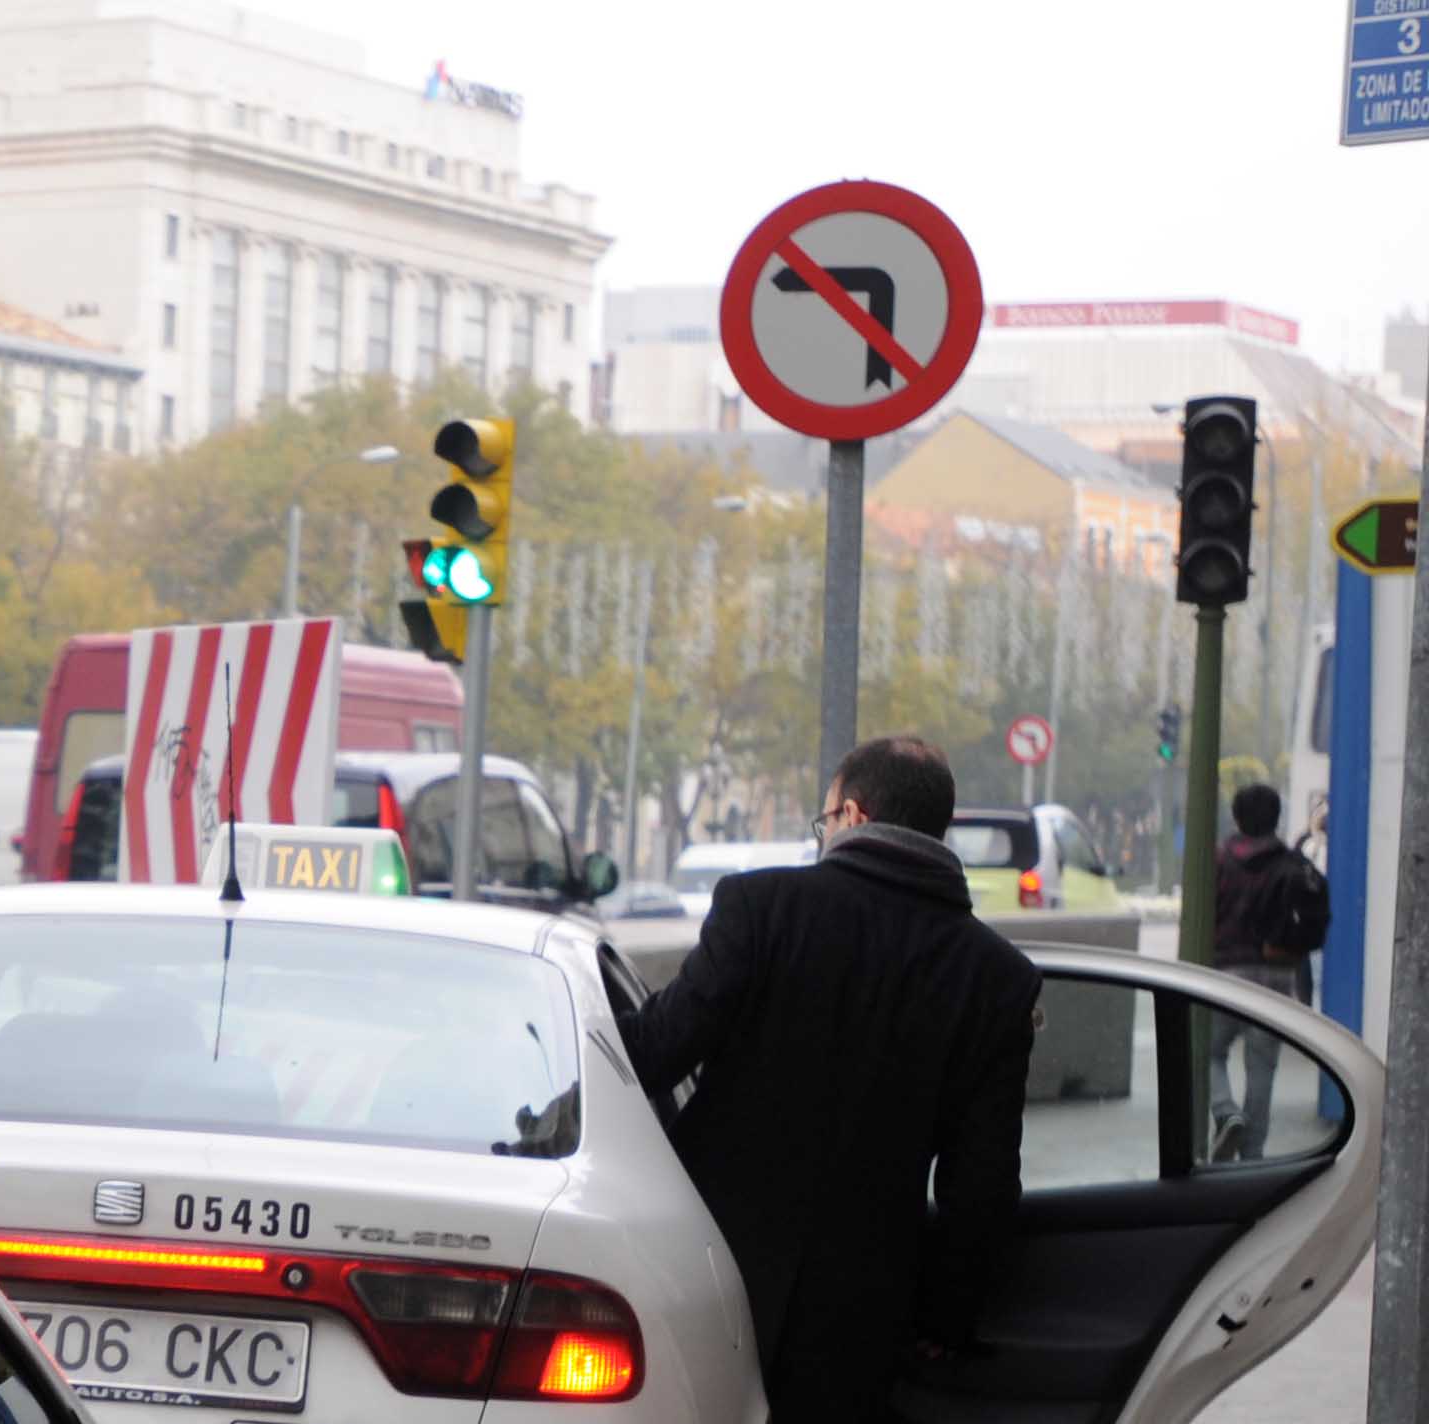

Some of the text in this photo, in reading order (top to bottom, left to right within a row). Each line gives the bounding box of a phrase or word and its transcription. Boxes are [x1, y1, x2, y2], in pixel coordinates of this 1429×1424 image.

[1397, 19, 1421, 54] 3
[1357, 69, 1423, 98] ZONA DE
[273, 846, 358, 889] TAXI
[174, 1193, 312, 1240] 05430
[334, 1224, 492, 1251] TOLEDO
[166, 1322, 285, 1388] CKC
